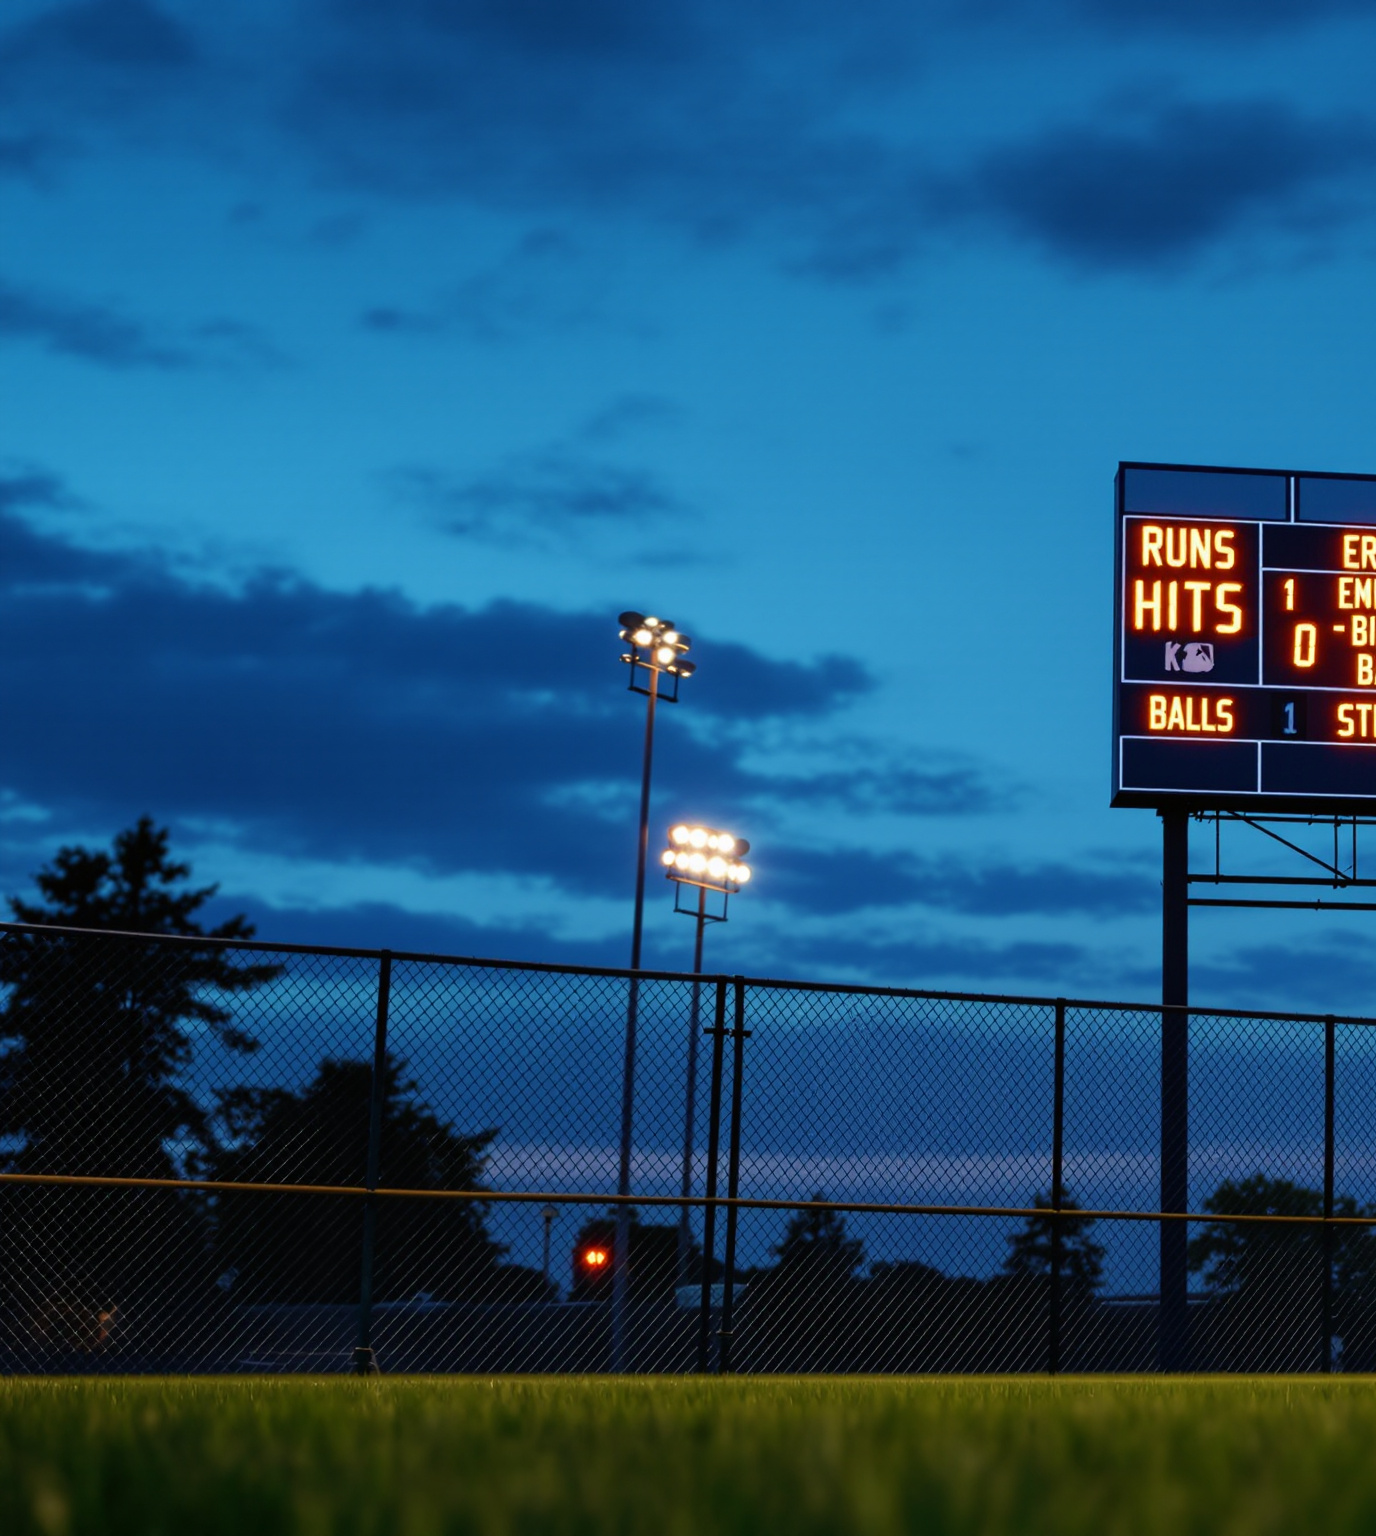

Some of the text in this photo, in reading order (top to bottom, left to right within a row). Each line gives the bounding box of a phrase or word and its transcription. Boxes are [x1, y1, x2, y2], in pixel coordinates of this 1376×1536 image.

[1142, 525, 1235, 569] RUNS
[1134, 580, 1242, 633] HITS
[1284, 579, 1294, 610] 1
[1294, 623, 1316, 667] 0
[1149, 695, 1234, 732] BALLS
[1283, 702, 1297, 734] 1
